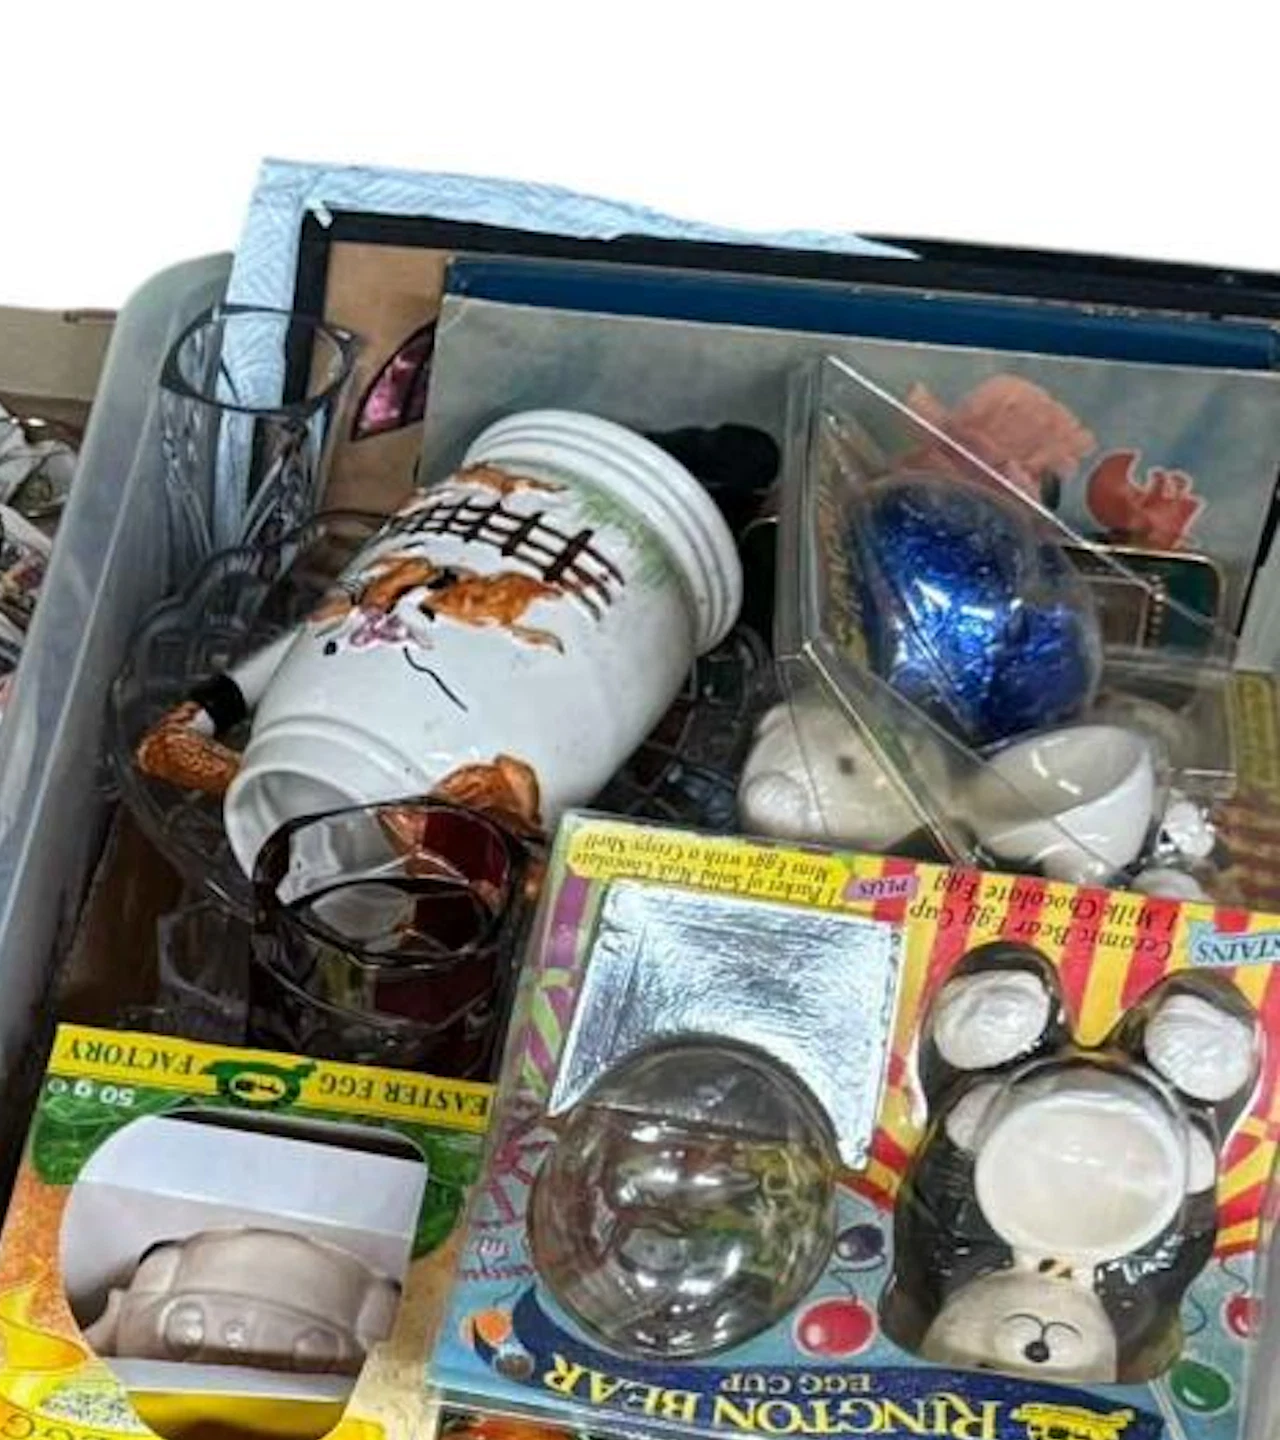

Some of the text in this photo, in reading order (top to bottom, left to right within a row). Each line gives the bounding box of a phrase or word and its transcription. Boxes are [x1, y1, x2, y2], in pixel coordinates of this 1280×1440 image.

[583, 833, 628, 853] Shell
[702, 848, 741, 868] with
[746, 850, 788, 878] Eggs
[858, 878, 909, 899] PLUS
[933, 867, 976, 895] Egg
[985, 883, 1098, 919] Chocolate
[1106, 895, 1157, 931] Milk
[909, 898, 1174, 963] Ceramic Bear Egg Cup
[69, 1037, 489, 1117] EASTER EGG FACTORY
[99, 1084, 136, 1108] 50
[543, 1353, 704, 1422] BEAR
[720, 1371, 871, 1395] EGG CUP
